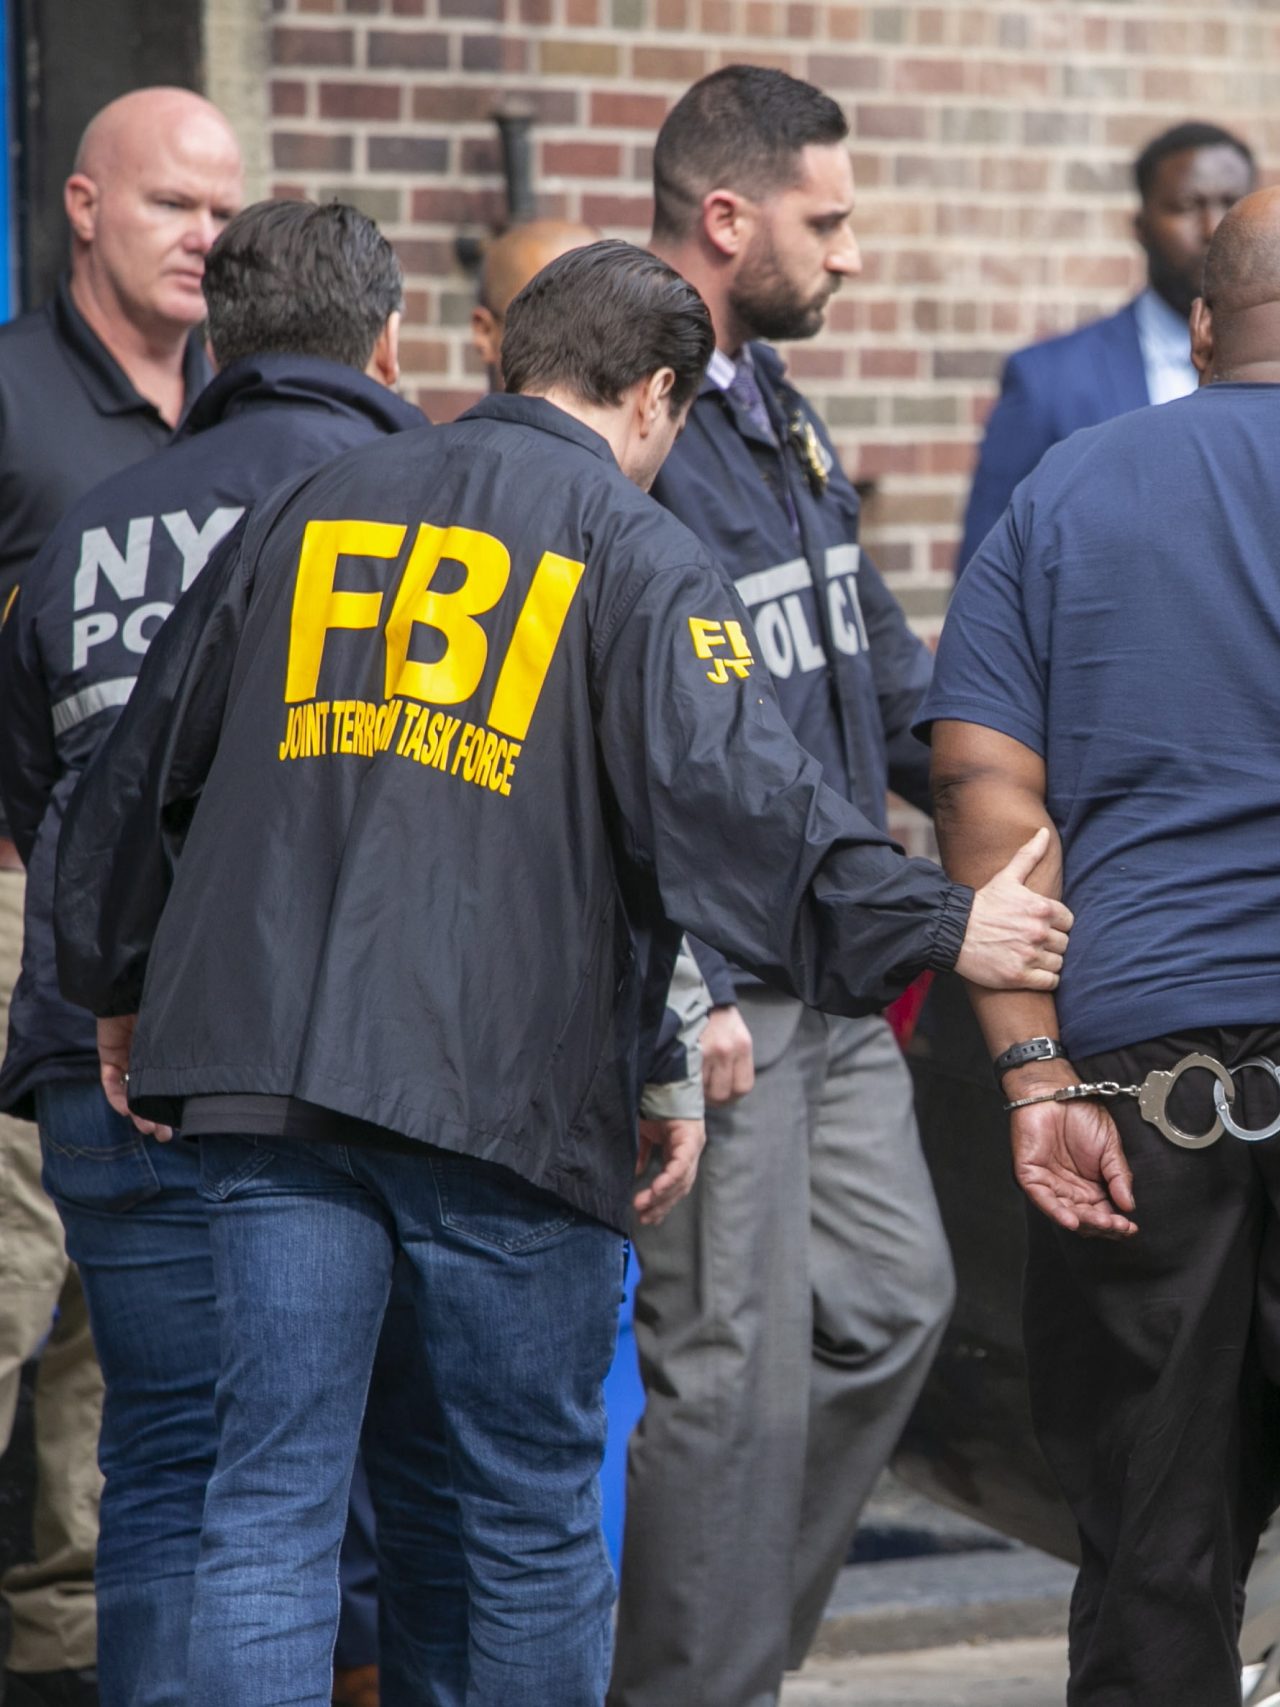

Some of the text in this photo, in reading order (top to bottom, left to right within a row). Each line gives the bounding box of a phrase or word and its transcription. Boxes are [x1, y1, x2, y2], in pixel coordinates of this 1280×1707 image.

[73, 506, 246, 612] NY
[285, 520, 586, 741] FBI
[279, 701, 330, 760] JOINT
[396, 701, 461, 771] TASK
[450, 722, 521, 796] FORCE
